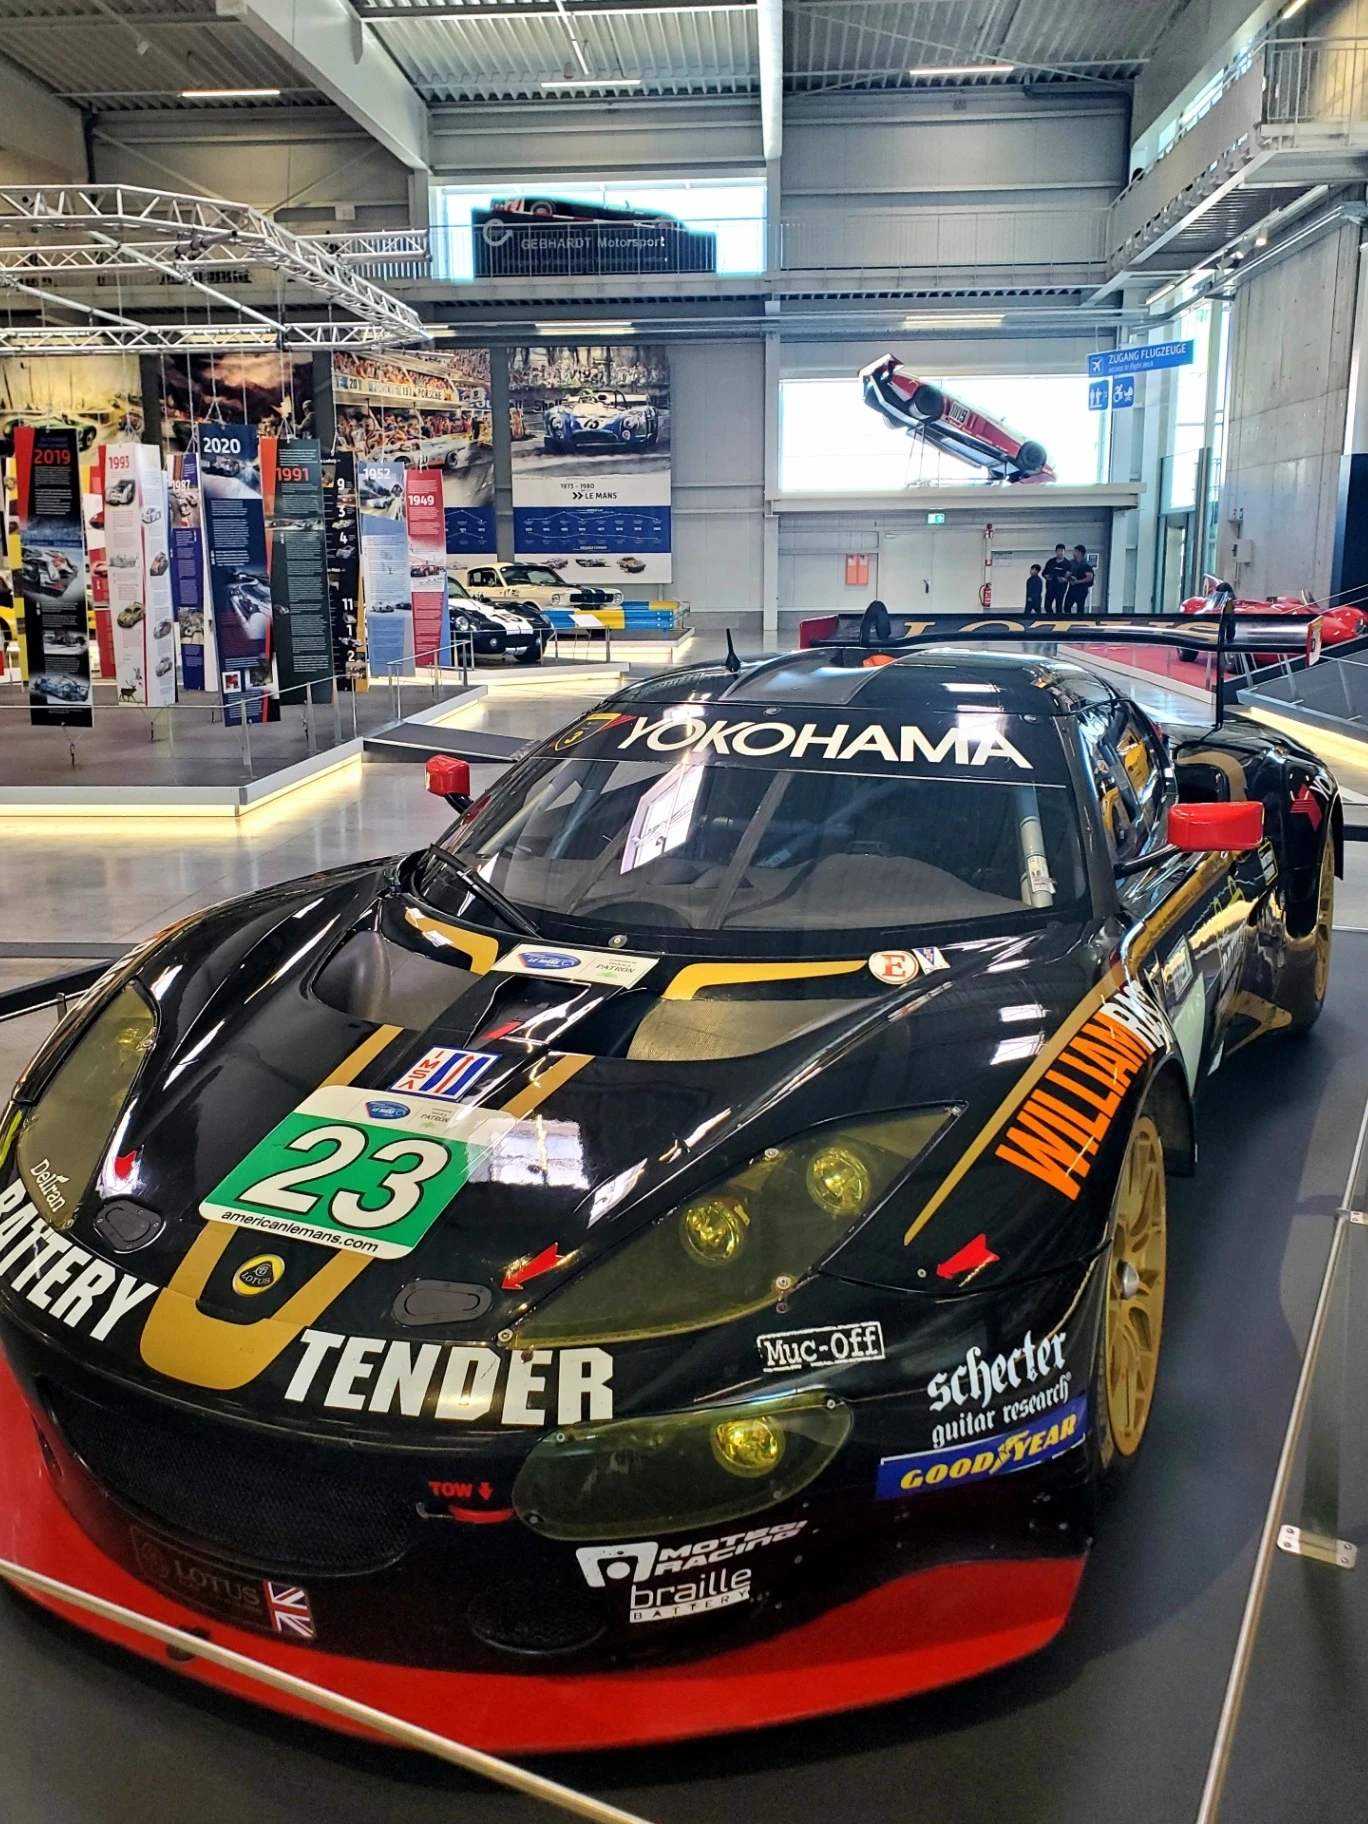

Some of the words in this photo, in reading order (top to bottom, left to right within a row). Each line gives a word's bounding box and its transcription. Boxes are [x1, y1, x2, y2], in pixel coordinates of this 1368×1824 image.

[521, 237, 592, 250] GEBHARDT
[597, 235, 665, 250] Motorsport
[1108, 350, 1140, 364] ZUGANG
[1140, 343, 1187, 358] FLUGZEUGE
[203, 437, 241, 454] 2020
[33, 449, 71, 465] 2019
[108, 456, 130, 469] 1993
[275, 467, 309, 482] 1991
[362, 467, 391, 480] 1952
[172, 479, 191, 492] 1987
[336, 477, 345, 491] 9
[408, 495, 435, 506] 1949
[585, 492, 594, 500] LE
[595, 491, 617, 500] MANS
[338, 504, 346, 517] 3
[340, 532, 348, 544] 4
[342, 598, 353, 611] 11
[347, 650, 356, 662] 2
[617, 716, 1034, 770] YOKOHAMA
[880, 954, 906, 978] E
[994, 1008, 1154, 1201] WILLIAM
[234, 1122, 454, 1230] 23
[221, 1210, 379, 1253] americanlemans.com
[241, 1271, 272, 1286] LOTUS
[763, 1325, 881, 1368] Muc-Off
[284, 1328, 614, 1426] TENDER
[927, 1329, 1067, 1412] schecter
[931, 1408, 996, 1450] guitar
[429, 1481, 473, 1498] TOW
[174, 1559, 261, 1606] LOTUS
[631, 1568, 752, 1609] braille
[633, 1590, 749, 1621] BATTERY
